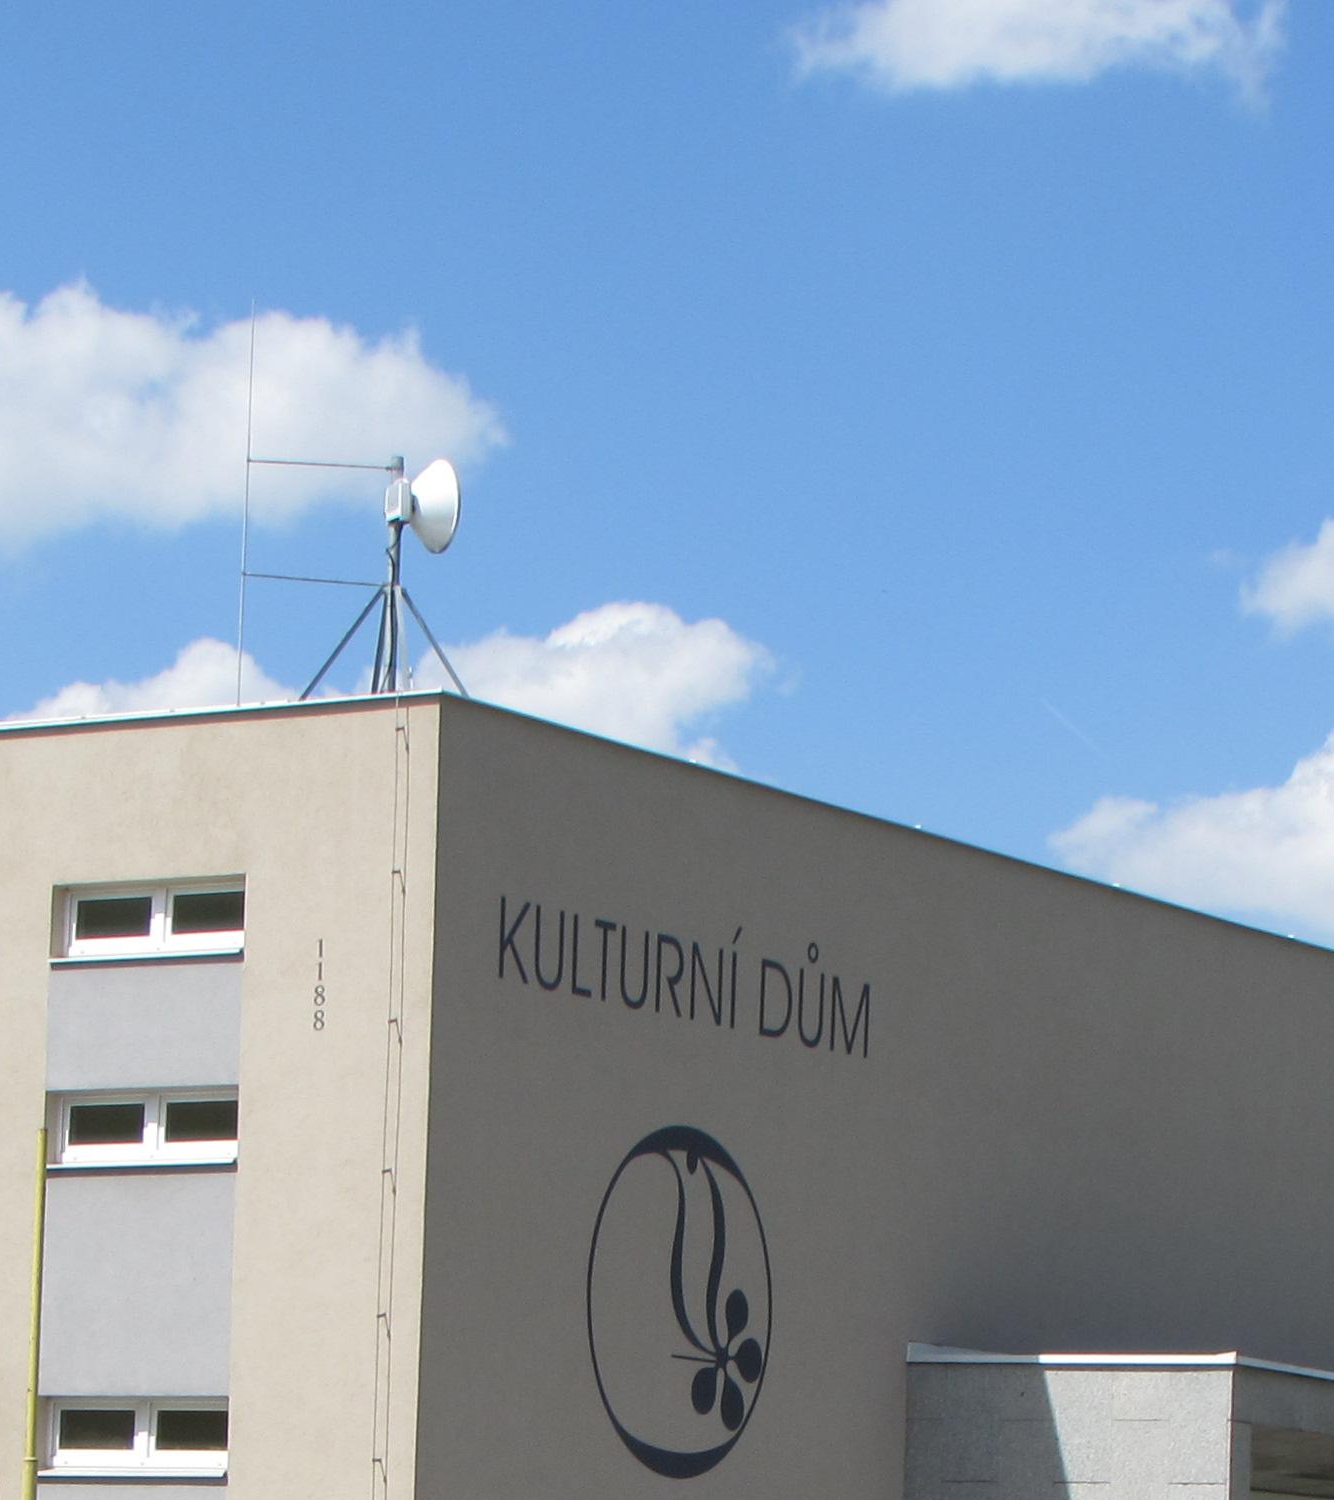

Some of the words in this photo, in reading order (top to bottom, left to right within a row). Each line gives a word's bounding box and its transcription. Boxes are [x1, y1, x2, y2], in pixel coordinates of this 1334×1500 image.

[312, 938, 326, 1031] 1188
[498, 895, 742, 1029] KULTURNÍ
[759, 942, 870, 1059] DŮM
